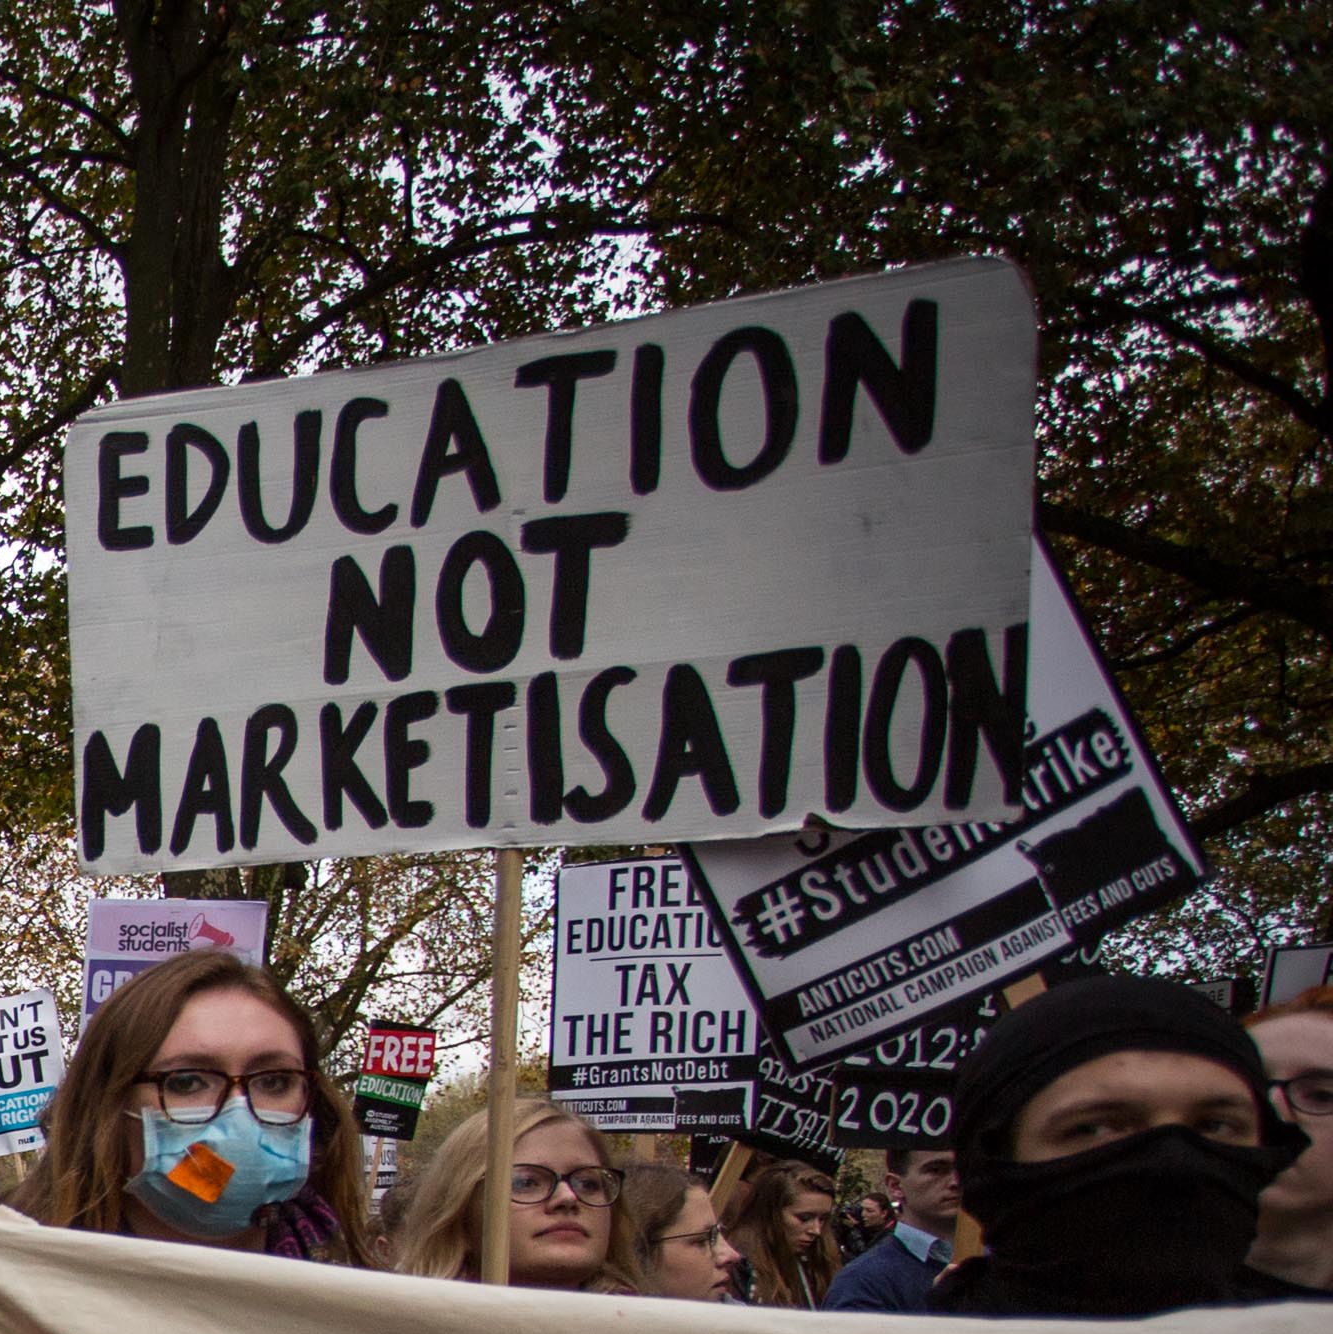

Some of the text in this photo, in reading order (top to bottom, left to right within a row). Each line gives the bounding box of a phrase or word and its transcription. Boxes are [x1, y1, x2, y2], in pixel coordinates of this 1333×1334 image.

[96, 298, 939, 553] EDUCATION
[324, 512, 630, 684] NOT
[82, 622, 1028, 860] MARKETISATION
[118, 935, 190, 952] students
[119, 921, 189, 939] socialist
[809, 992, 904, 1044] NATIONAL
[905, 951, 999, 1004] CAMPAIGN
[1062, 893, 1101, 928] FEES
[1101, 877, 1131, 911] AND
[1132, 856, 1176, 897] CUTS
[614, 962, 692, 1006] TAX
[796, 925, 962, 1018] ANTICUTS.COM
[13, 1026, 46, 1049] US
[365, 1034, 432, 1074] FREE
[563, 1010, 746, 1057] THE RICH
[359, 1076, 423, 1104] EDUCATION
[572, 1060, 729, 1086] #GrantsNotDebt
[598, 1115, 637, 1126] CAMPAIGN
[677, 1114, 697, 1125] FEES
[699, 1114, 717, 1125] AND
[718, 1114, 741, 1125] CUTS
